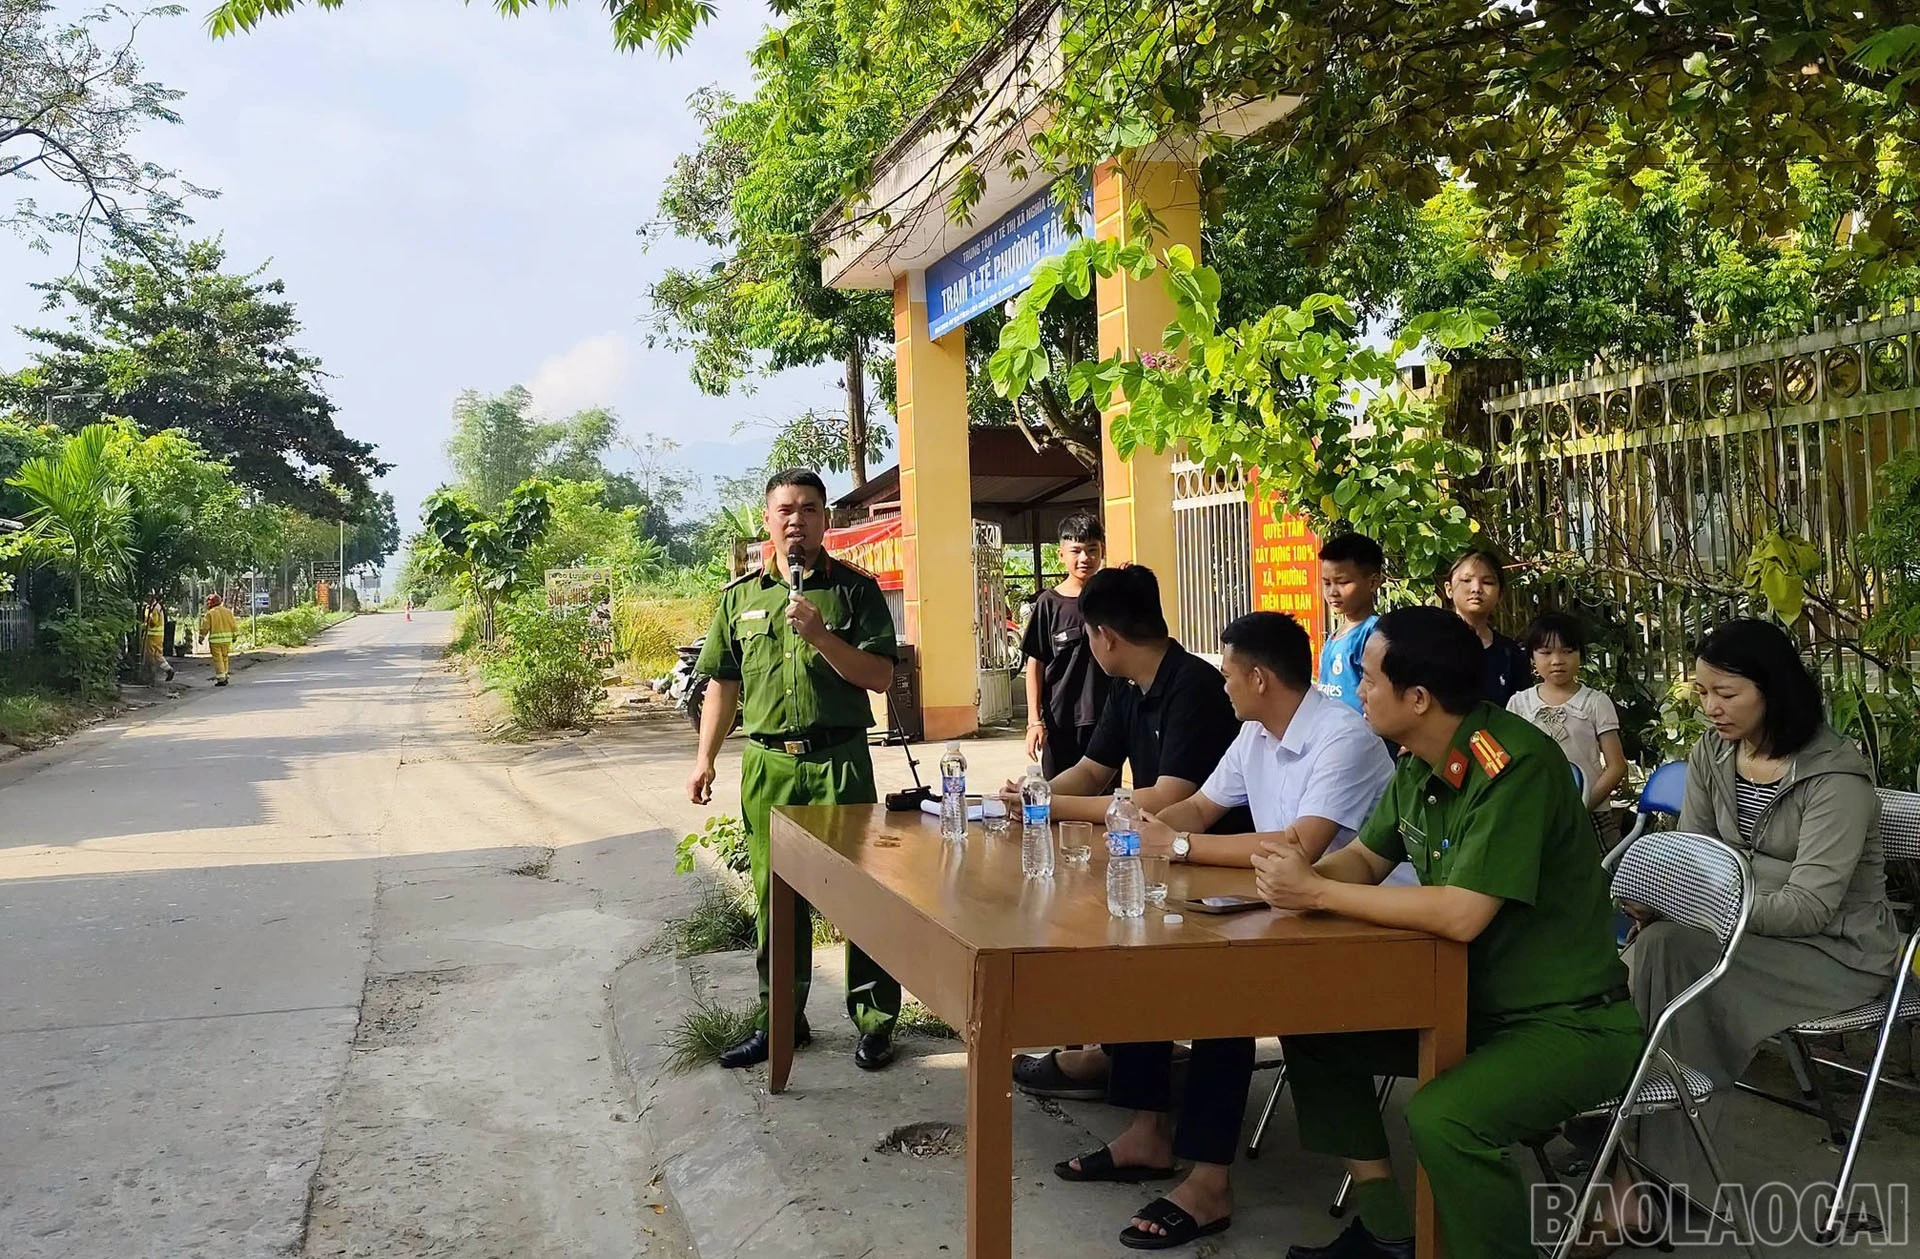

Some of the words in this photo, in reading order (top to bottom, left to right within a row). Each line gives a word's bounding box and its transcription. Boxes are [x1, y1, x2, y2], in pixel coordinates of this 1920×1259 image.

[962, 243, 981, 264] TRUNG
[981, 234, 993, 252] TÂM
[999, 222, 1006, 240] TẾ
[1006, 216, 1016, 233] THỊ
[1016, 210, 1026, 228] XÃ
[1026, 197, 1046, 221] NGHĨA
[941, 275, 968, 314] TRẠM
[969, 270, 977, 297] Y
[978, 250, 992, 292] TẾ
[993, 230, 1040, 285] PHƯỜNG
[1255, 544, 1269, 564] XÂY
[1269, 545, 1291, 566] DỰNG
[1292, 544, 1315, 562] 100%
[1275, 566, 1308, 586] PHƯỜNG
[1260, 591, 1279, 611] TRÊN
[1294, 590, 1312, 611] BÀN
